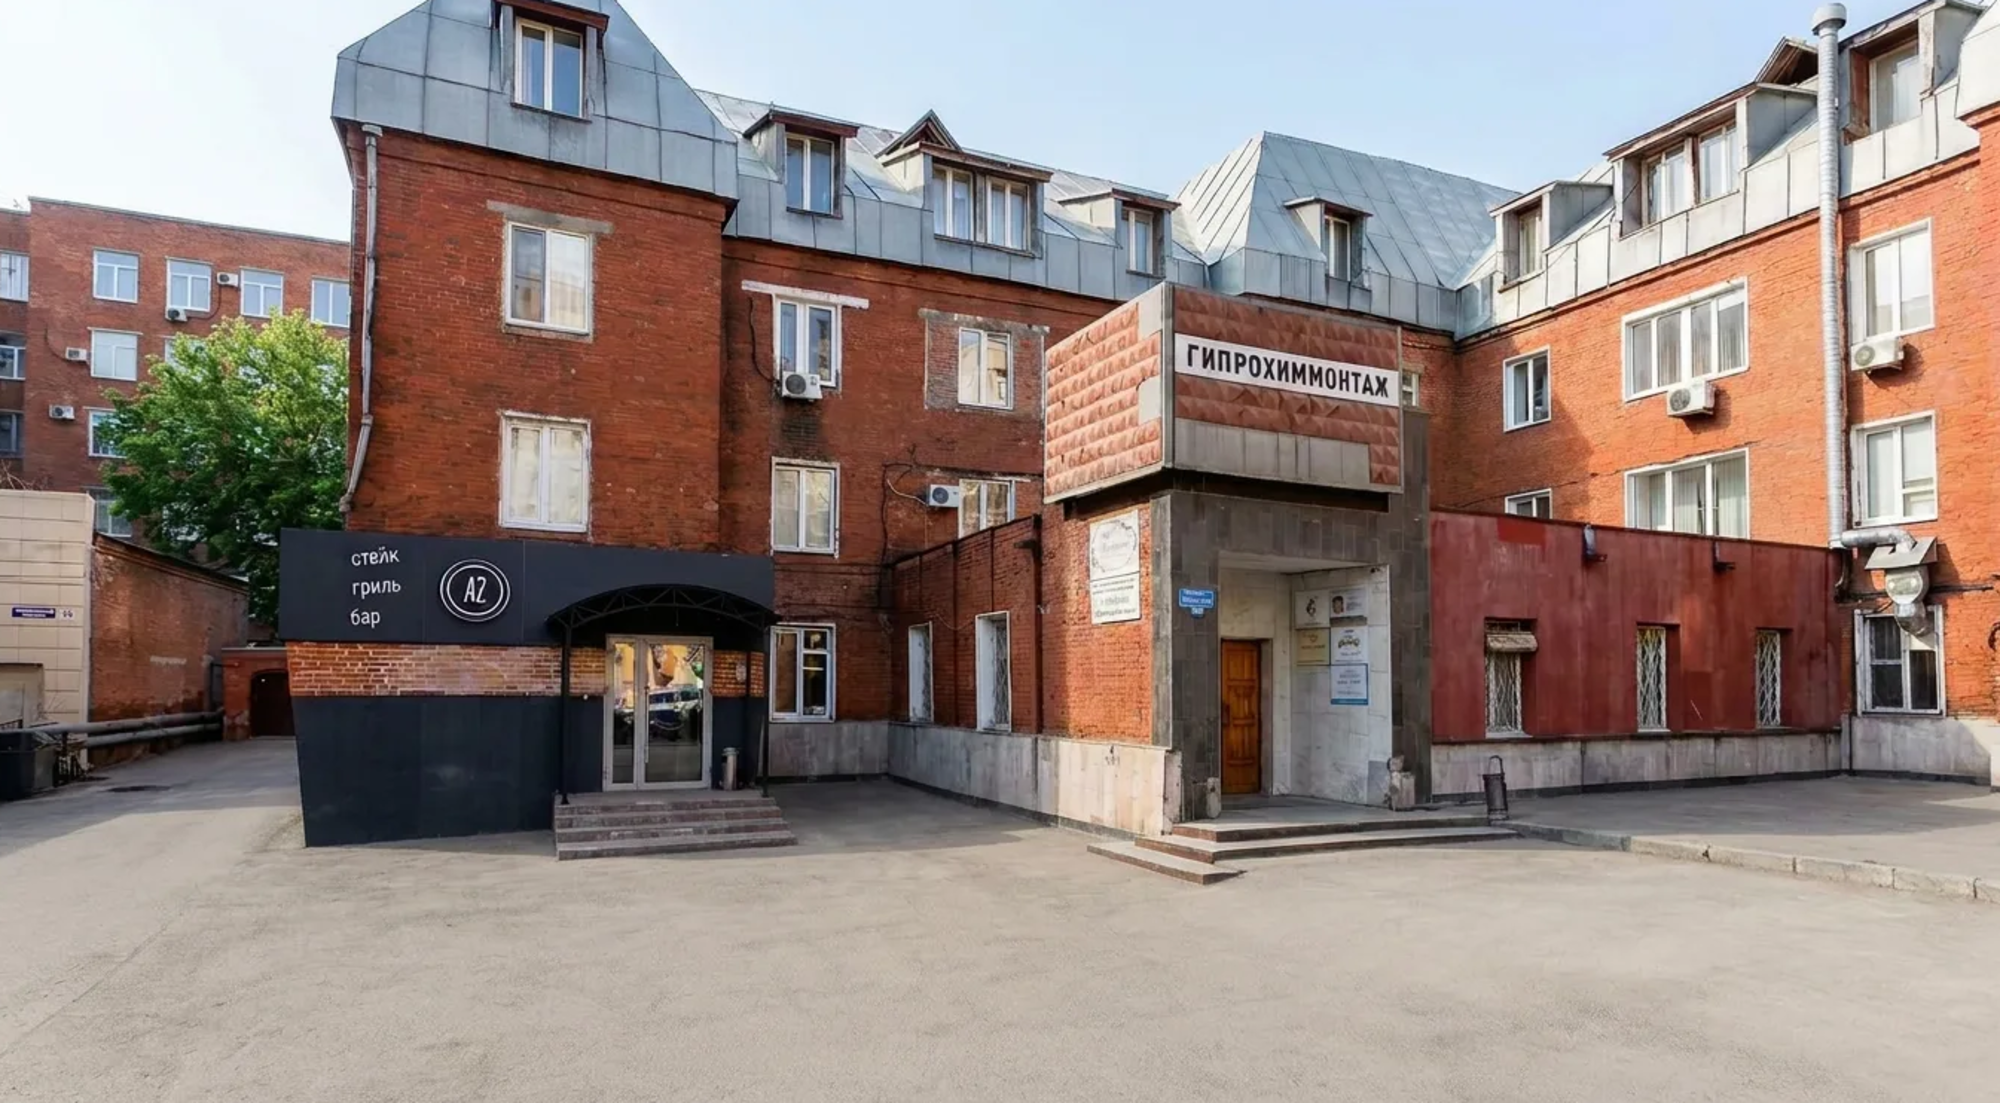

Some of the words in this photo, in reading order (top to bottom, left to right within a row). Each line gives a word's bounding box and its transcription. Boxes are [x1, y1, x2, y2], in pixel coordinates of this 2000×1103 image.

[1187, 343, 1389, 398] ГИПРОХИММОНТАЖ
[351, 546, 400, 567] стейк
[352, 580, 401, 599] гриль
[350, 608, 381, 629] бар
